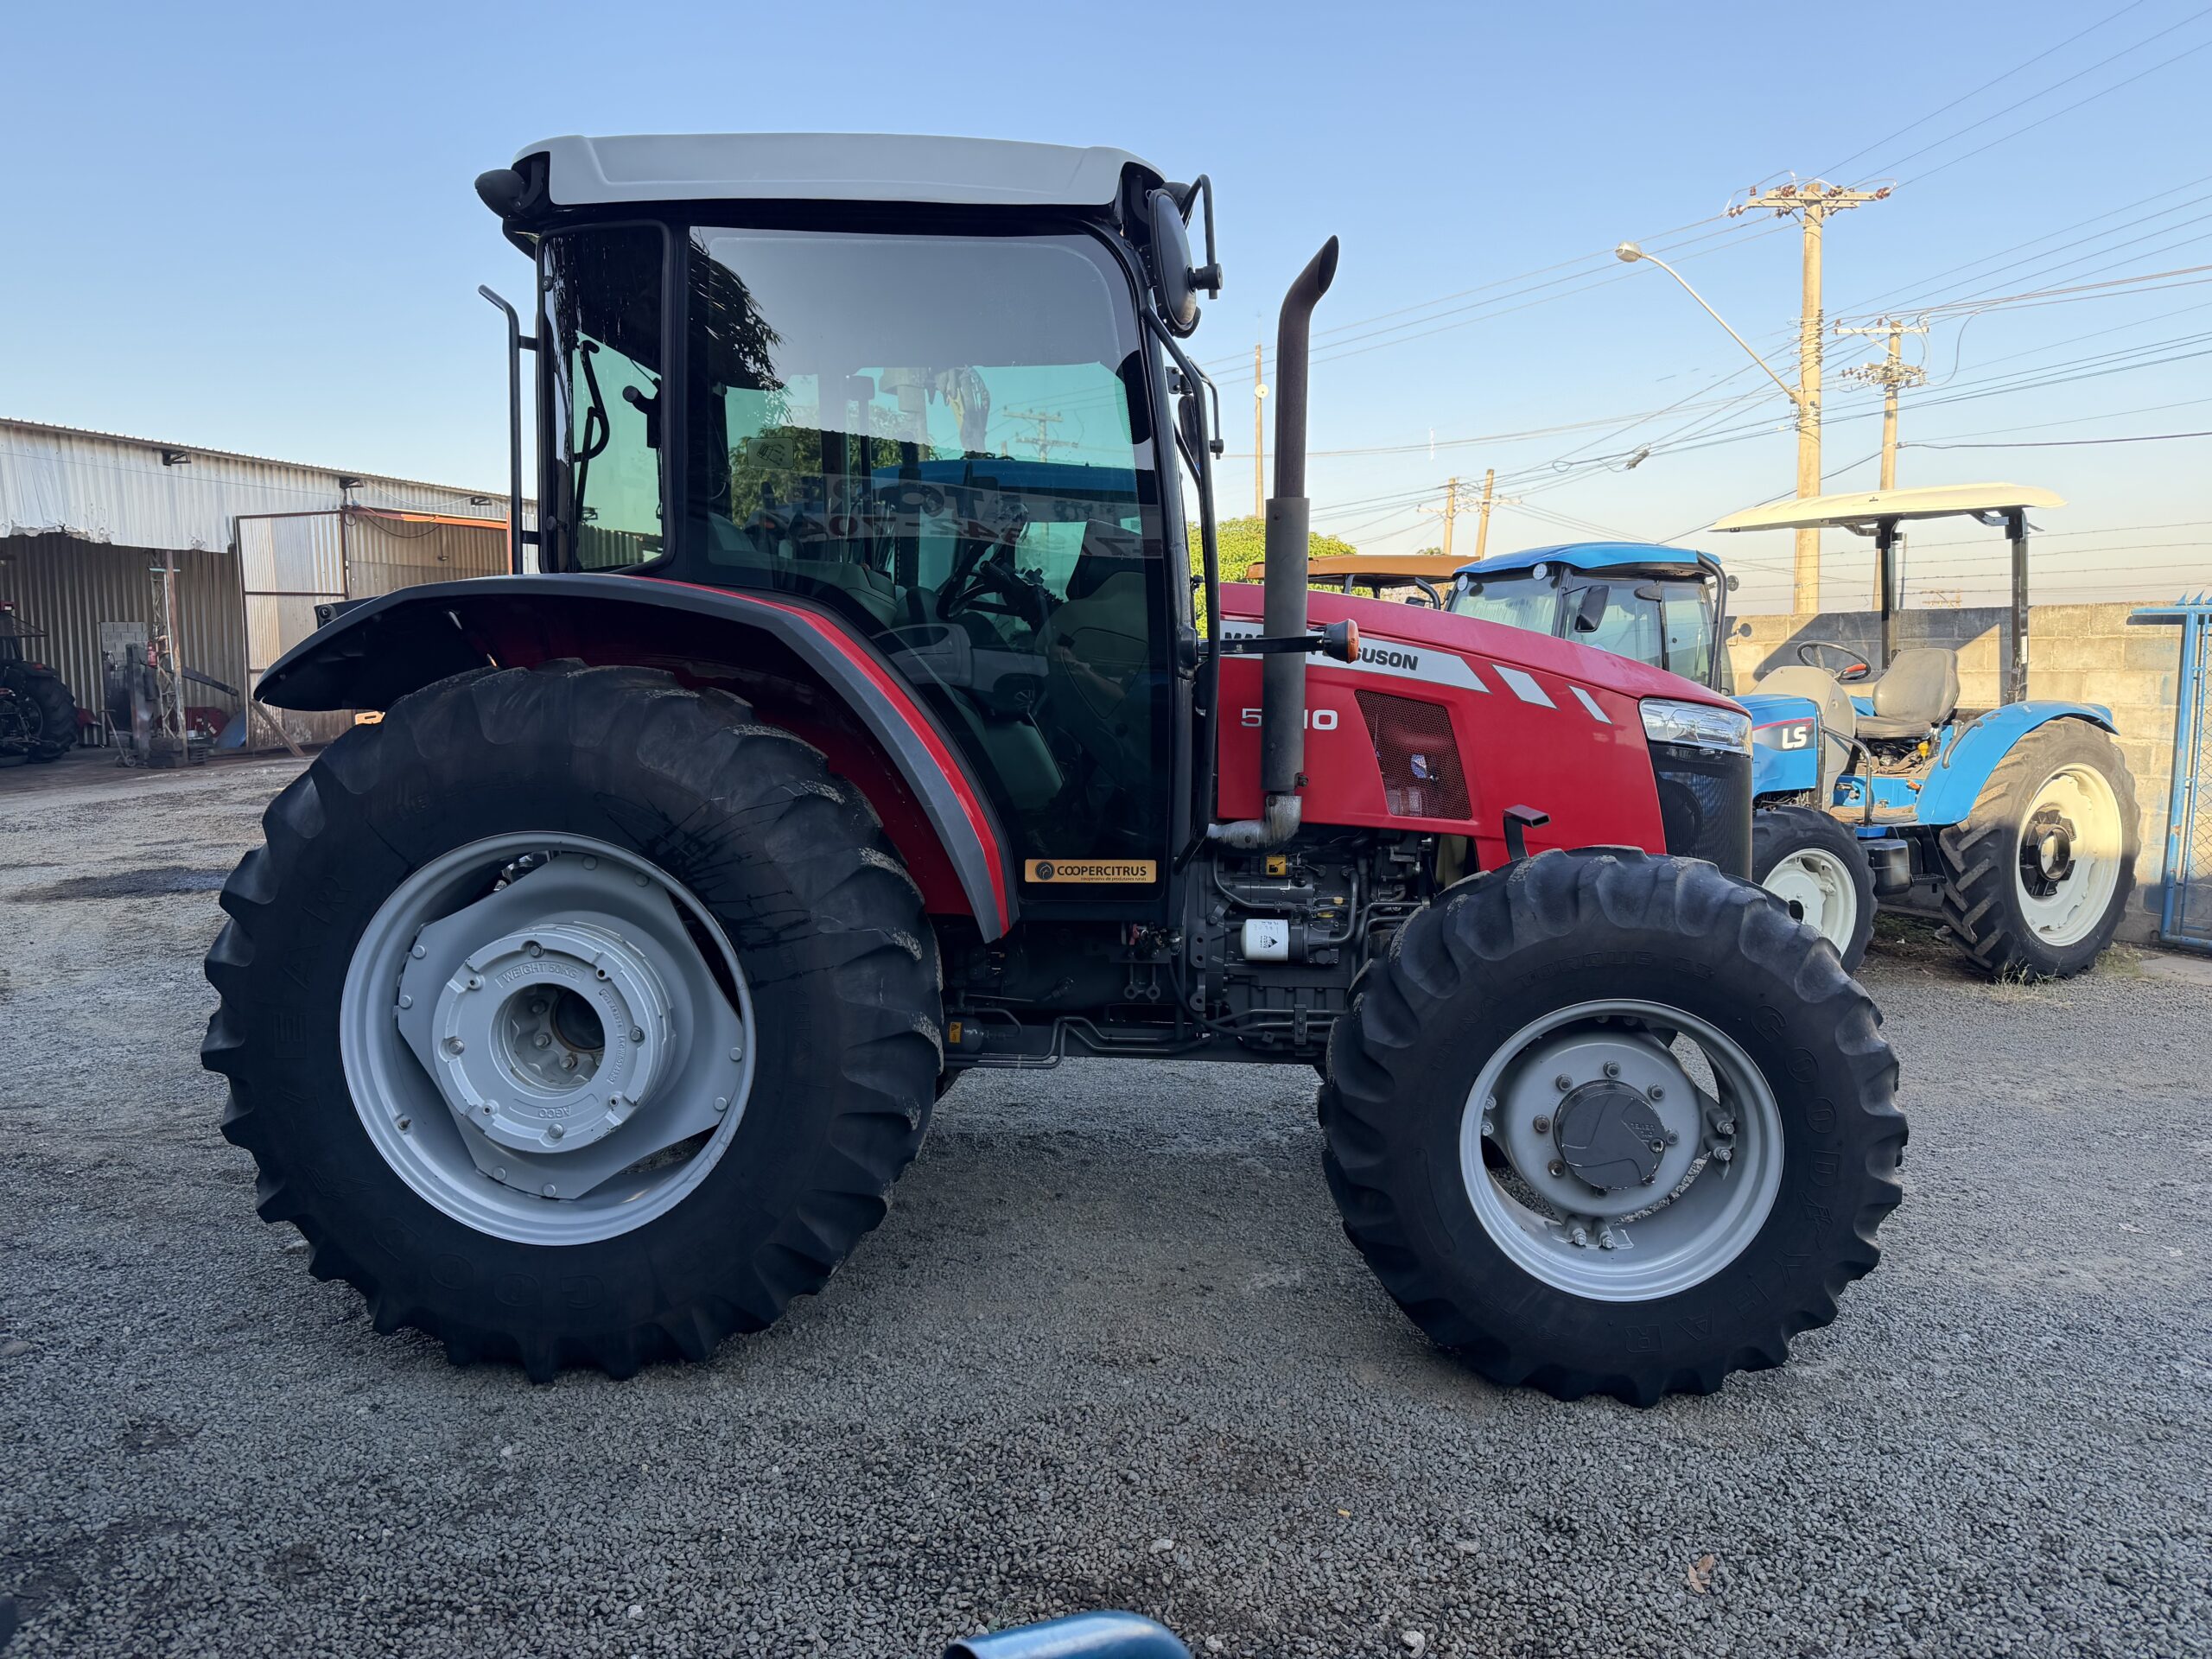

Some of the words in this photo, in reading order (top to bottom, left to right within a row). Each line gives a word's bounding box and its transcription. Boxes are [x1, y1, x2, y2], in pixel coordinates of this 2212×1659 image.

[1782, 726, 1808, 749] LS
[1057, 865, 1147, 877] COOPERCITRUS
[502, 963, 547, 983] WEIGHT
[550, 962, 581, 979] 50KG
[537, 1106, 572, 1119] AGCO
